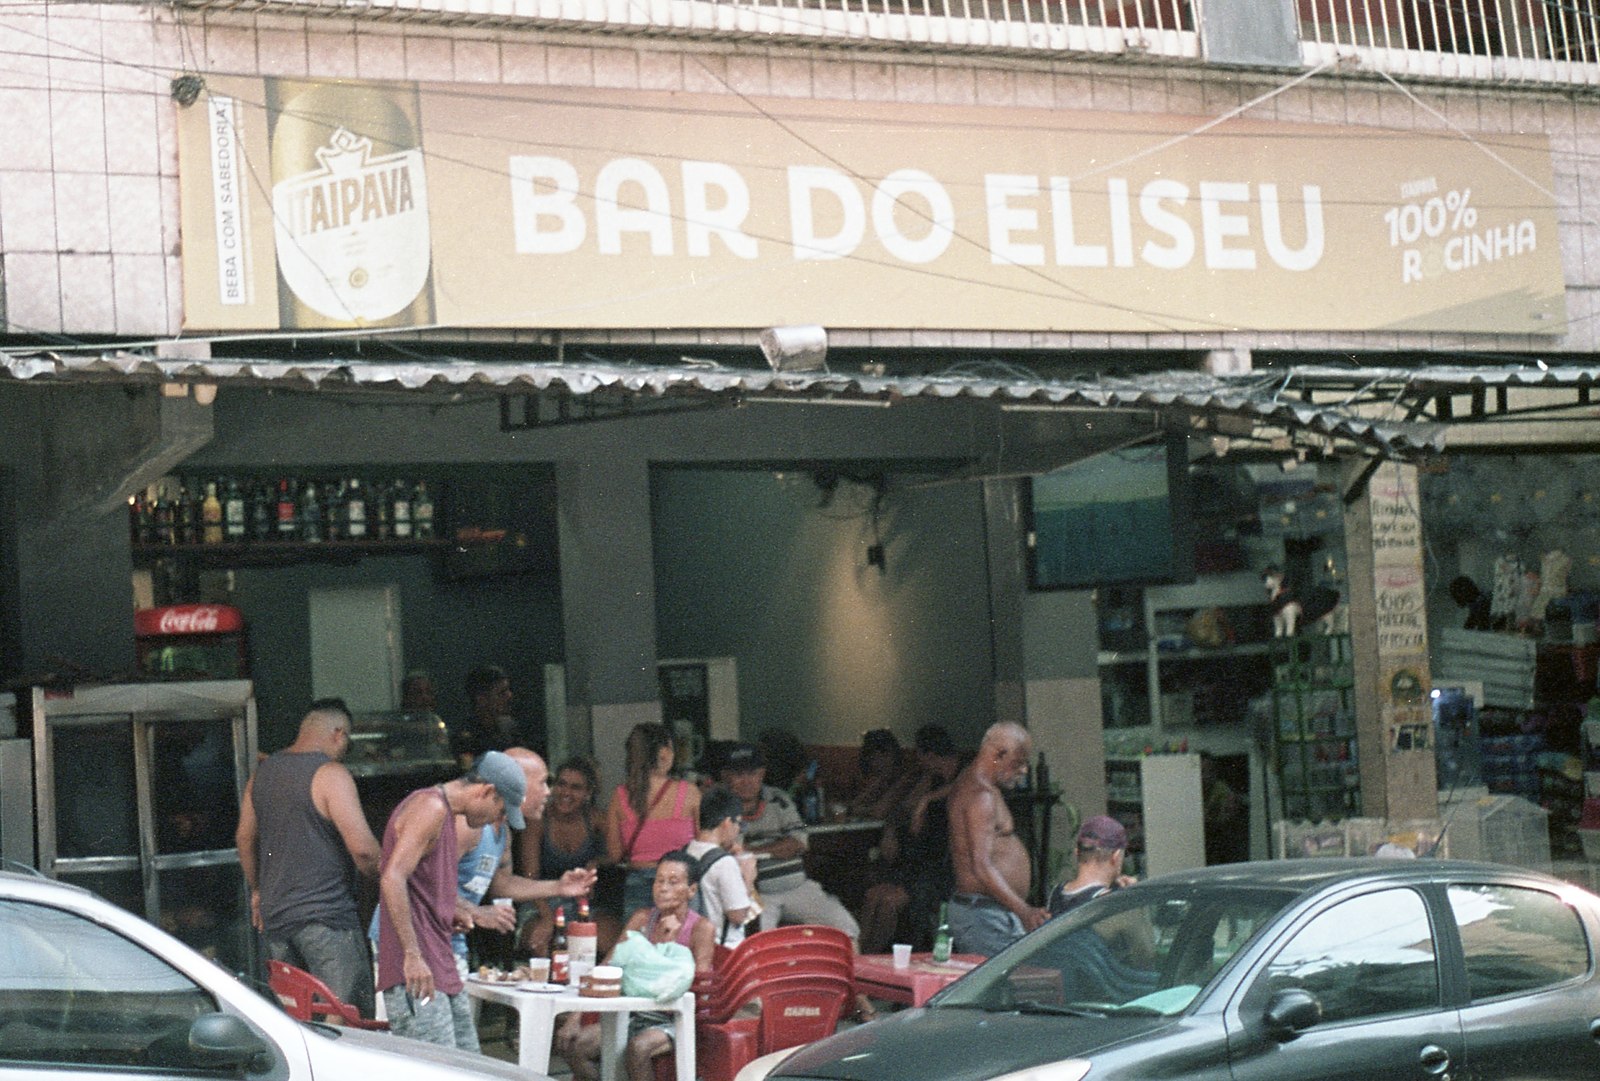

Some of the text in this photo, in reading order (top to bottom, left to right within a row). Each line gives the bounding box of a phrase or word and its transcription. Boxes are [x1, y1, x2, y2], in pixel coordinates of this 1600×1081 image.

[216, 108, 239, 299] BEBA COM SABEDORIA
[286, 164, 415, 236] ITAIPAVA
[508, 155, 1325, 272] BAR DO ELISEU
[1384, 187, 1478, 247] 100%
